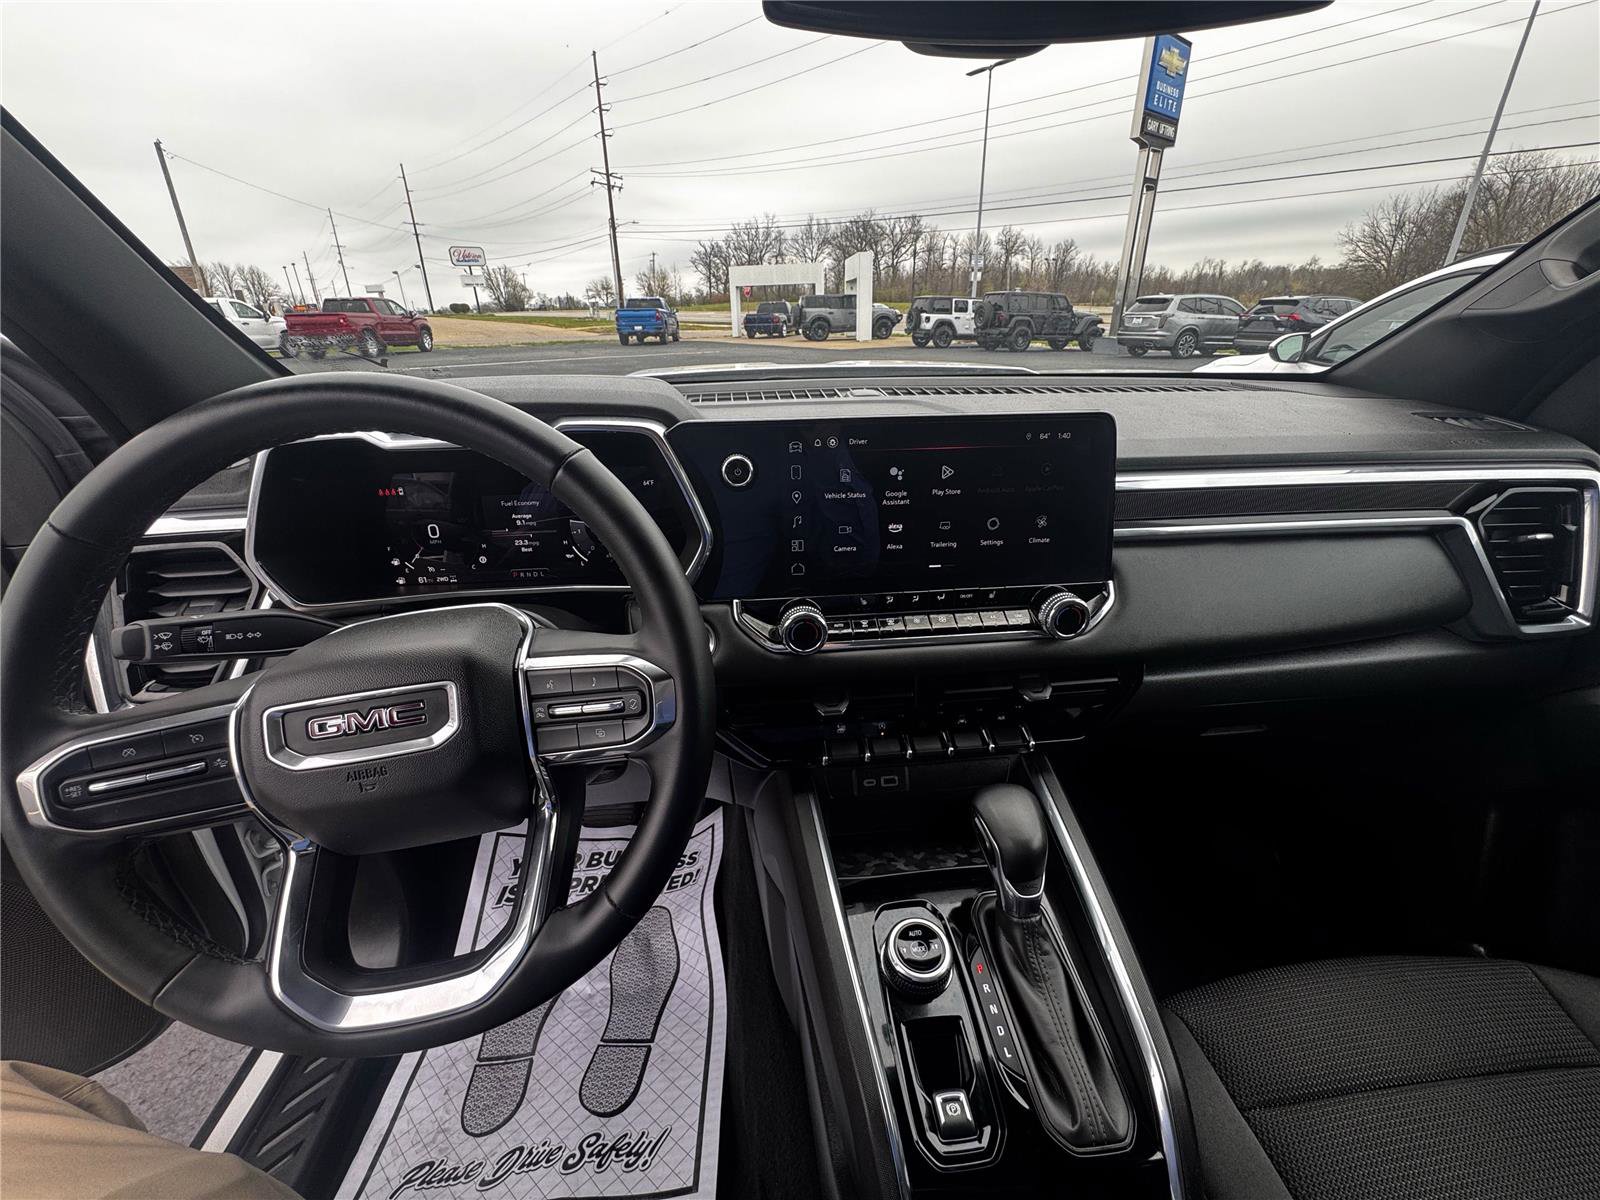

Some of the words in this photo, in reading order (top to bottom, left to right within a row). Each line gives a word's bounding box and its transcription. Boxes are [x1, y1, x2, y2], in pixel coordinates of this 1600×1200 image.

[1156, 80, 1179, 98] BUSINESS
[1153, 94, 1177, 112] ELITE
[885, 490, 908, 498] Google
[931, 488, 945, 496] Play
[514, 500, 540, 508] Economy
[427, 523, 440, 539] 0
[930, 541, 957, 549] Trailering
[980, 539, 1004, 547] Settings
[308, 701, 426, 739] GMC
[346, 766, 388, 782] AIRBAG
[908, 929, 923, 937] AUTO
[977, 963, 983, 974] P
[982, 983, 990, 993] R
[989, 1003, 998, 1015] N
[996, 1025, 1005, 1036] D
[1003, 1047, 1012, 1058] L
[389, 1159, 484, 1200] Please
[478, 1141, 563, 1189] Drive
[561, 1125, 672, 1174] Safely!
